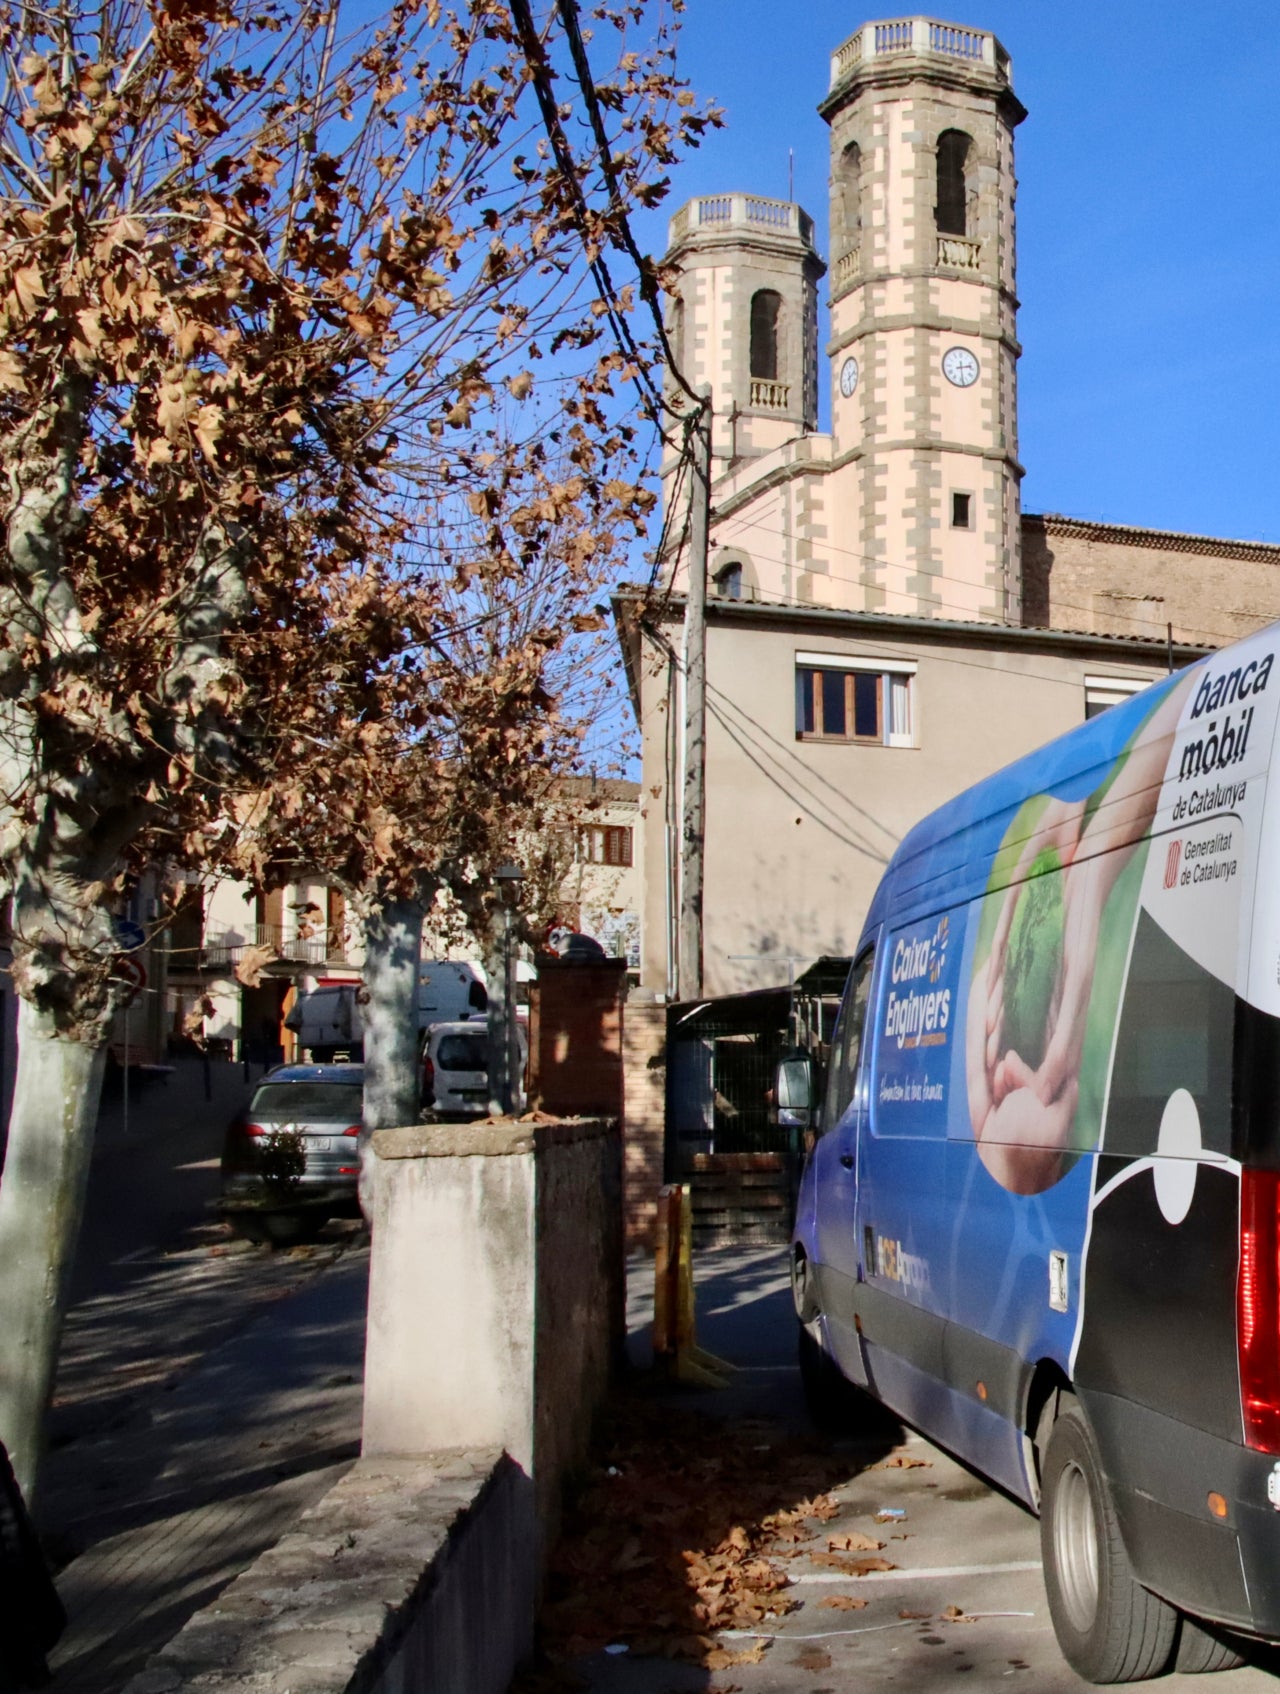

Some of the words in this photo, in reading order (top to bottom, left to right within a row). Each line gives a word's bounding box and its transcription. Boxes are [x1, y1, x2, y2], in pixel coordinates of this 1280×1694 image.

[1190, 653, 1274, 720] banca
[1172, 795, 1187, 821] de
[1188, 781, 1247, 816] Catalunya
[1184, 832, 1232, 860] Generalitat
[1180, 866, 1191, 886] de
[1193, 860, 1237, 883] Catalunya
[892, 938, 931, 984] Caixa
[885, 989, 950, 1049] Enginyers
